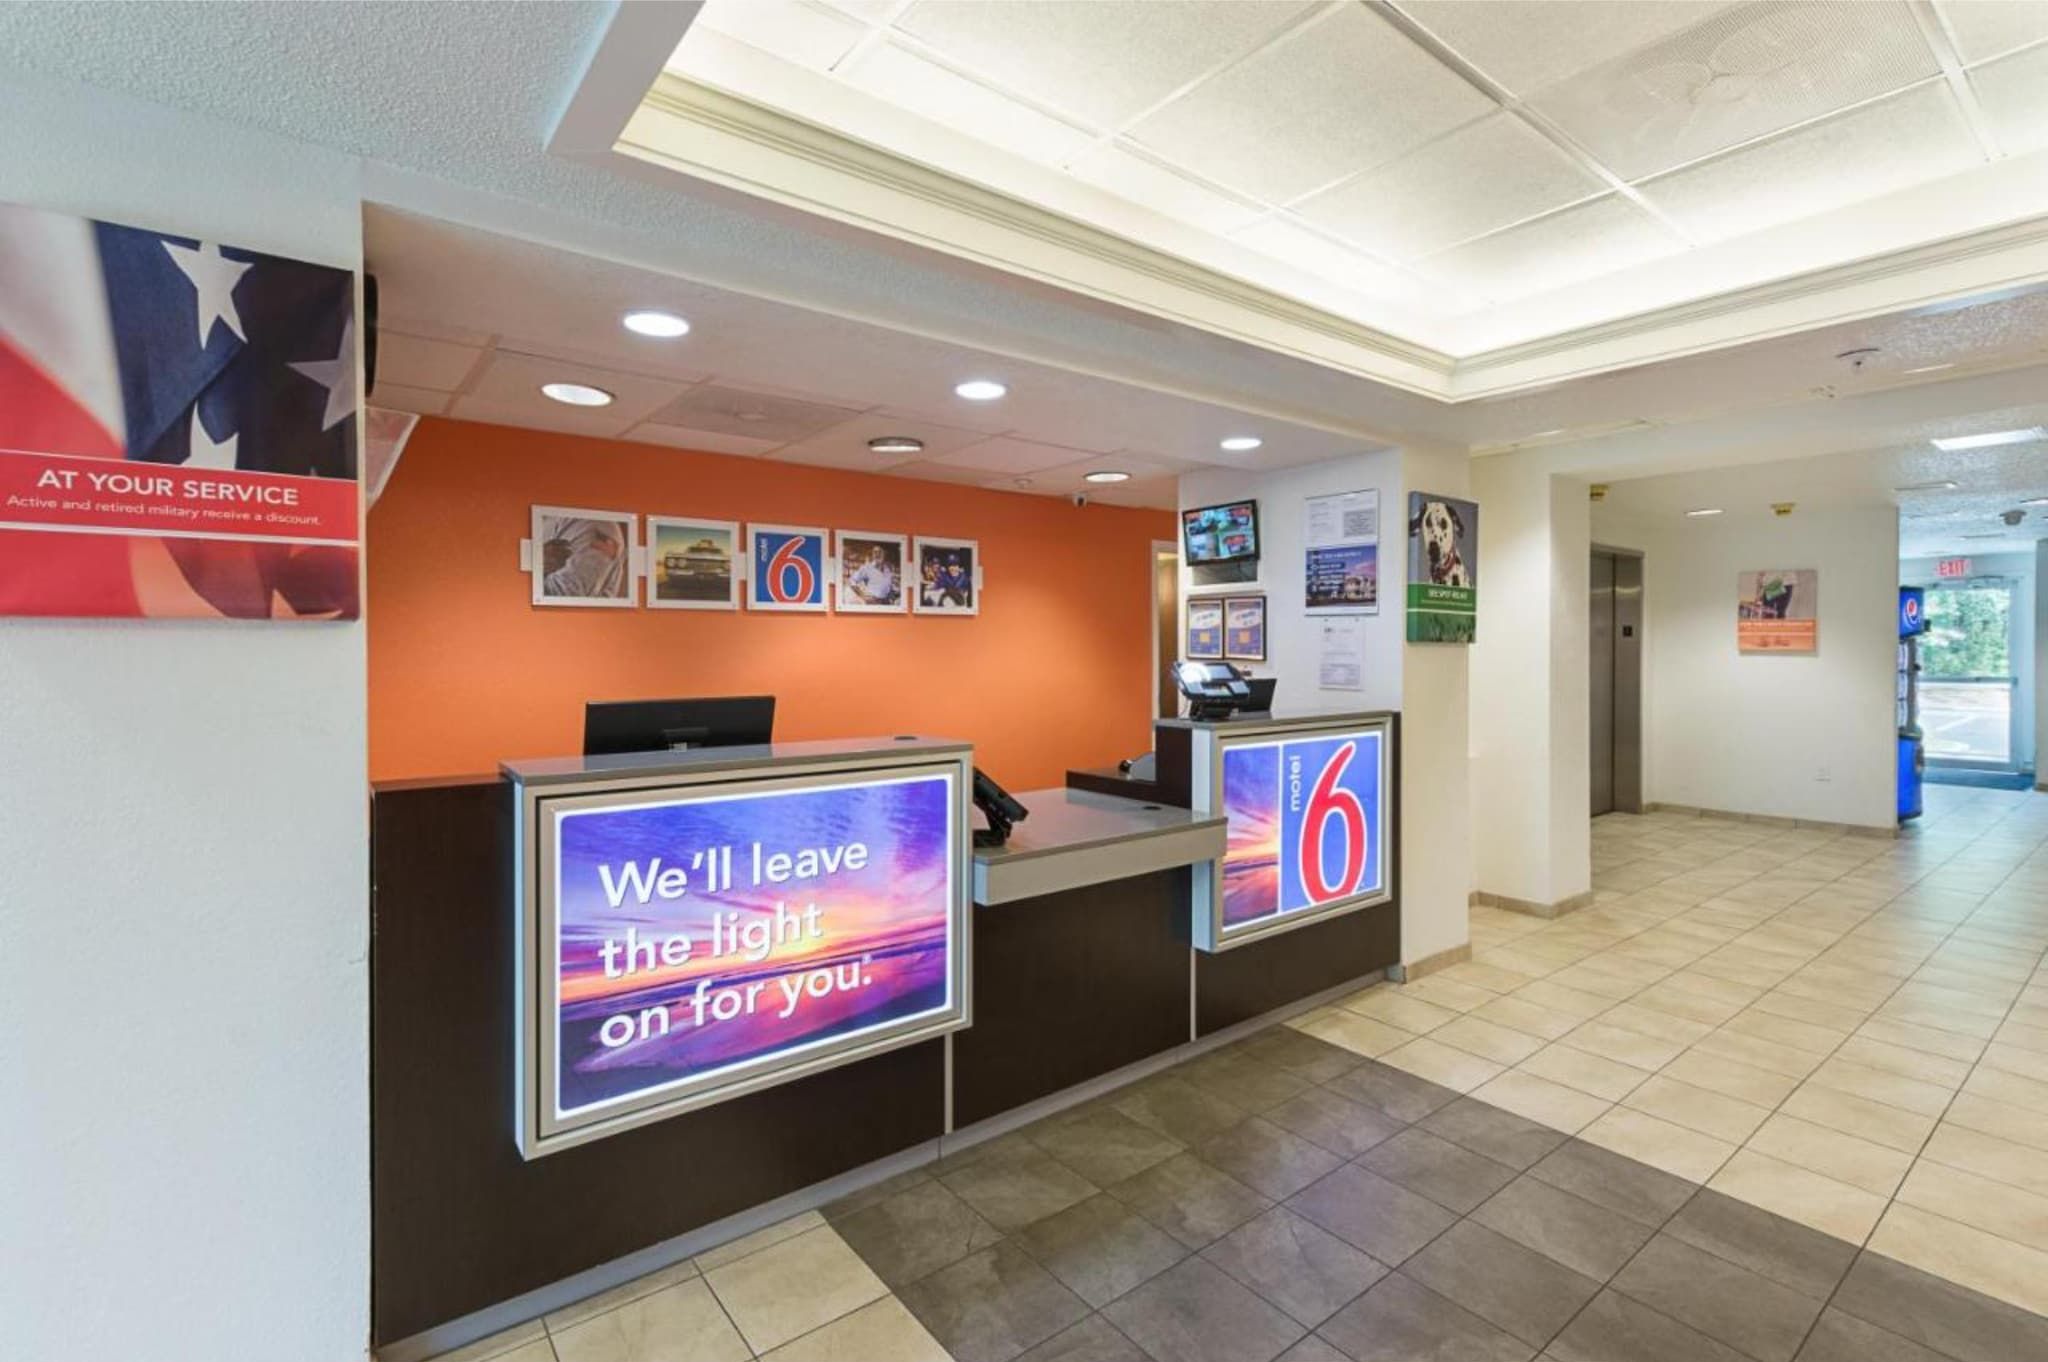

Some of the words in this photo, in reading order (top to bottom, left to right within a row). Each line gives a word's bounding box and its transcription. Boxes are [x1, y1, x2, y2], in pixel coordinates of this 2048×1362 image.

[7, 495, 57, 509] Active
[62, 500, 91, 511] and
[95, 502, 145, 515] retired
[148, 505, 200, 520] military
[203, 510, 250, 521] receive
[254, 514, 263, 522] a
[265, 513, 322, 526] discount.
[37, 469, 79, 490] AT
[87, 472, 173, 497] YOUR
[183, 480, 299, 506] SERVICE
[767, 536, 814, 603] 6
[1289, 755, 1301, 812] motel
[1299, 740, 1368, 906] 6
[598, 846, 733, 908] We'll
[752, 842, 869, 884] leave
[598, 926, 692, 979] the
[712, 901, 824, 961] light
[599, 1004, 671, 1047] on
[690, 980, 768, 1028] for
